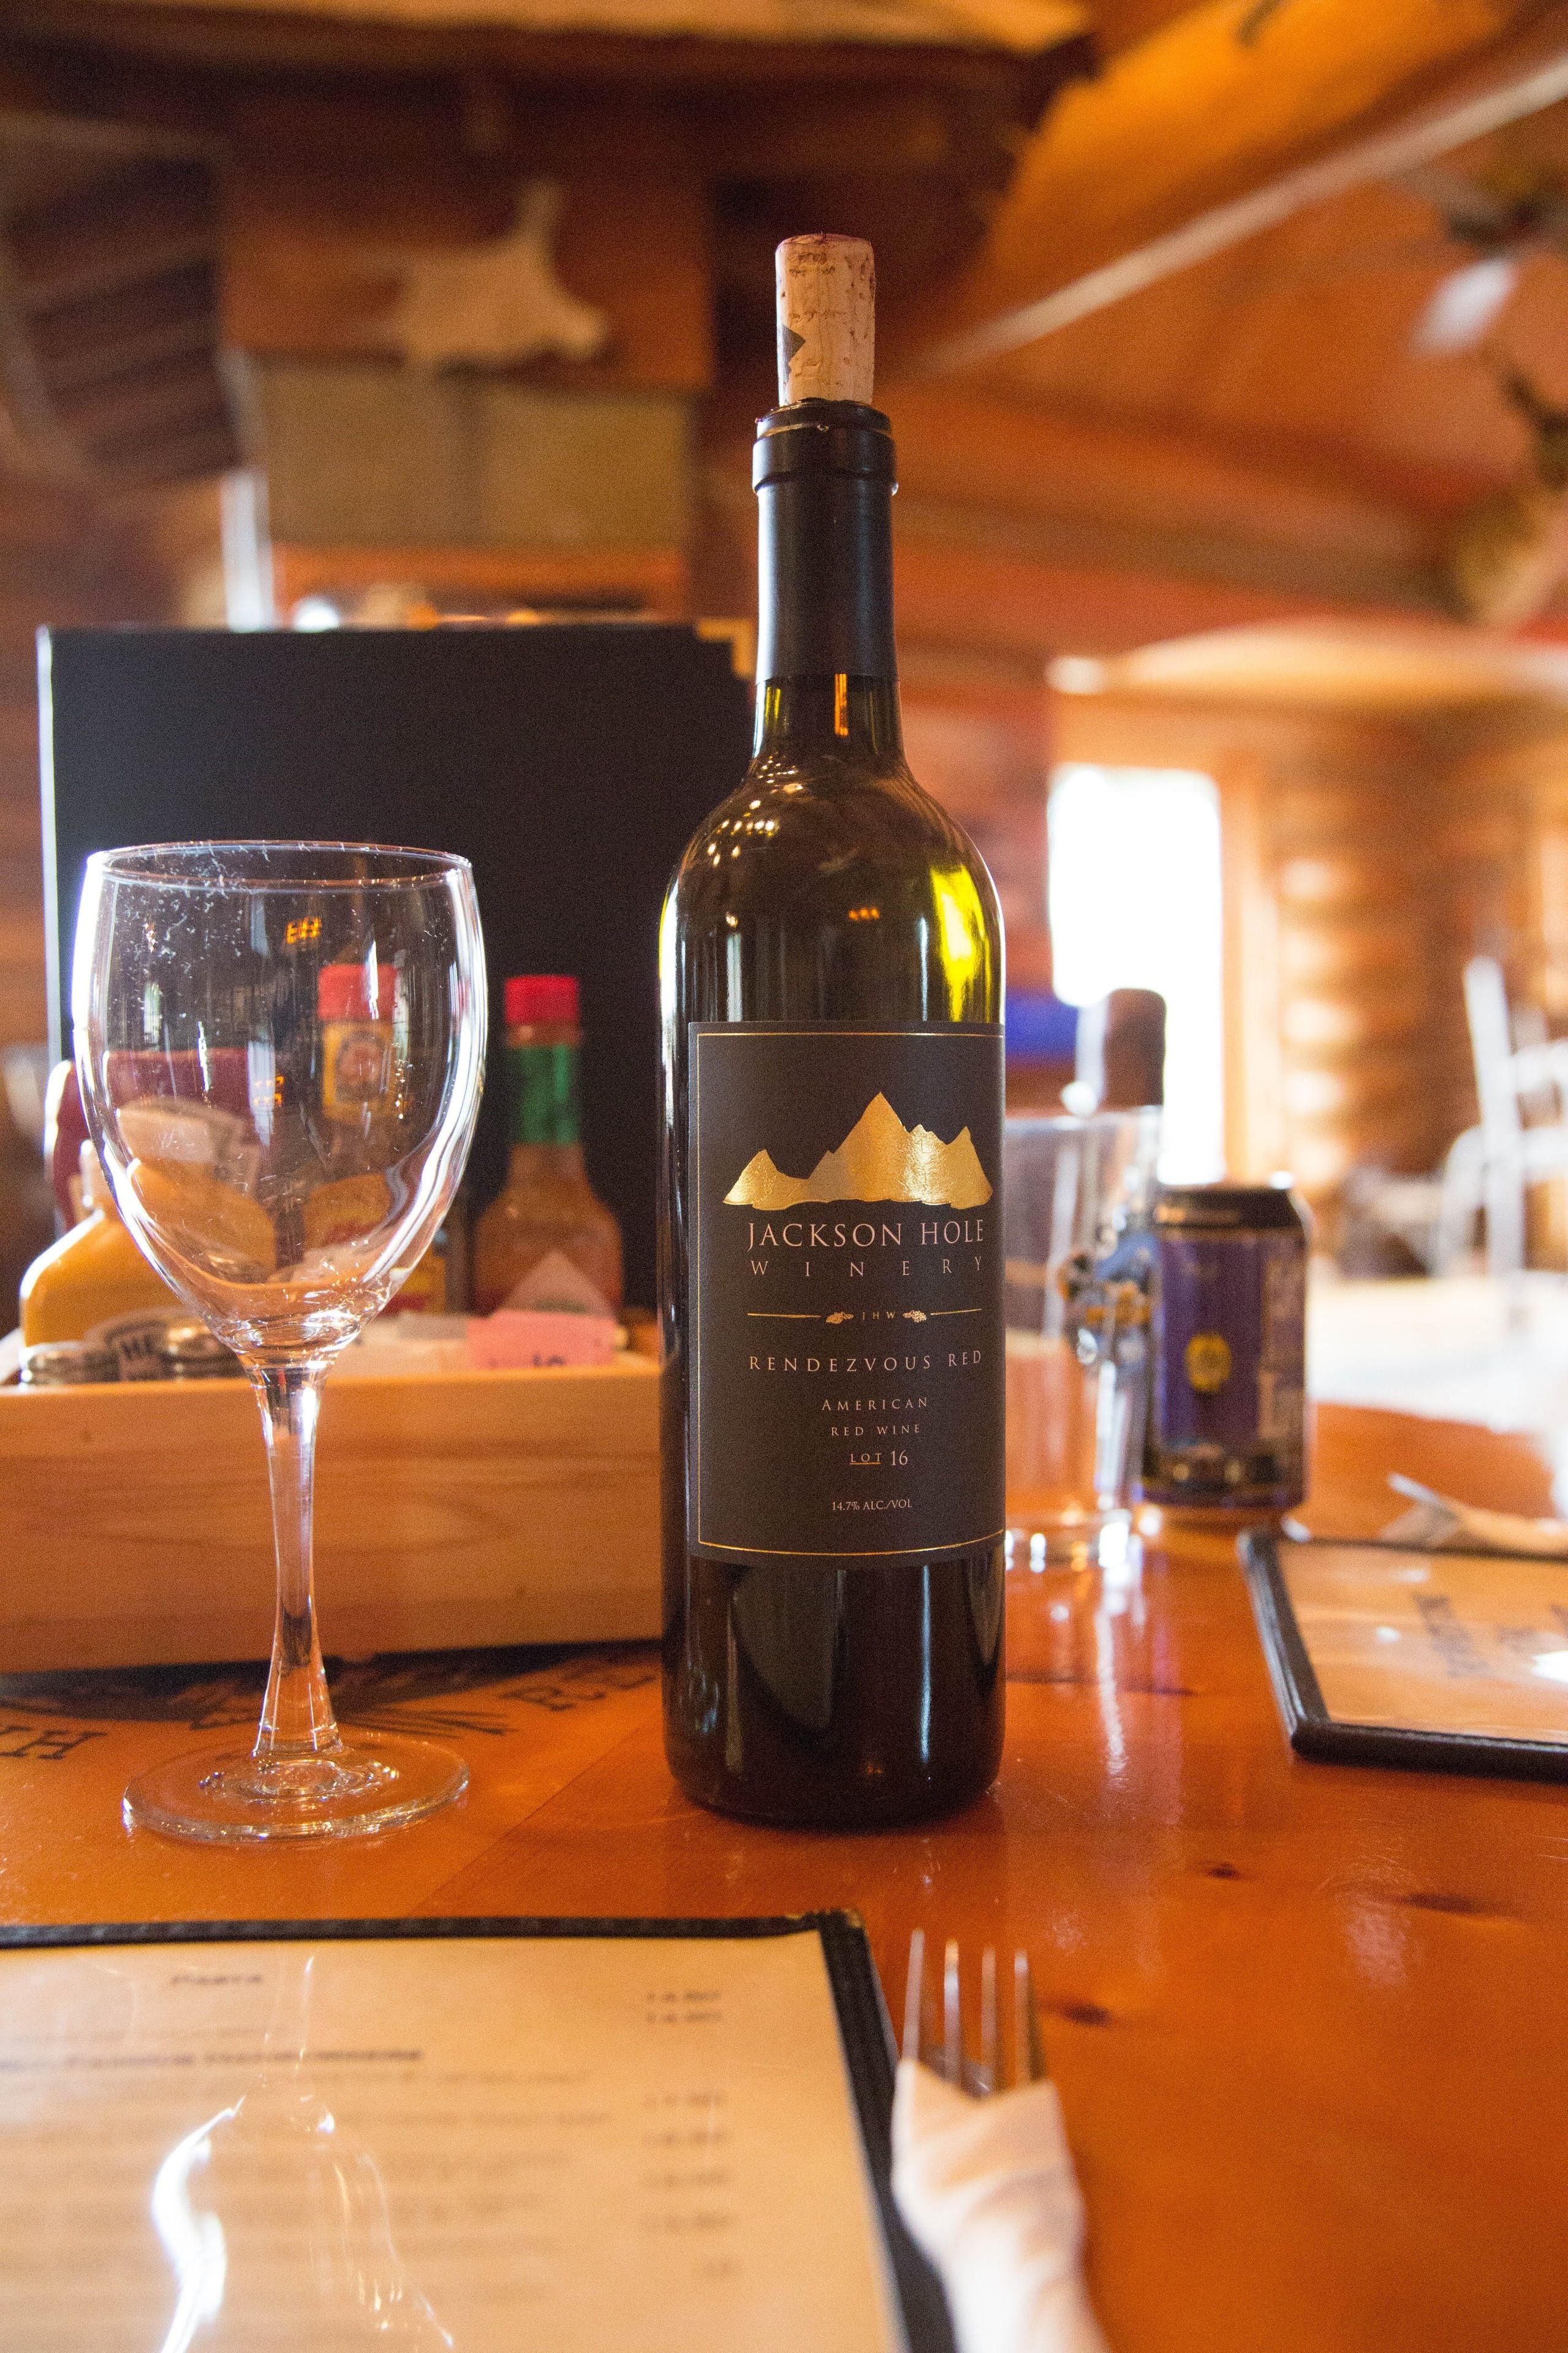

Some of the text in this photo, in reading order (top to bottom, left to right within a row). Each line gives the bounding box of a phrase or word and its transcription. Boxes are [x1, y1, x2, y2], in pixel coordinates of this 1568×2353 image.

[748, 1219, 983, 1251] JACKSON HOLE
[750, 1256, 982, 1277] WINERY
[749, 1350, 982, 1372] RENDEZVOUS RED
[822, 1397, 928, 1411] AMERICAN
[831, 1424, 921, 1436] RED WINE
[850, 1450, 908, 1466] LOT 16
[832, 1501, 860, 1511] 14.7%
